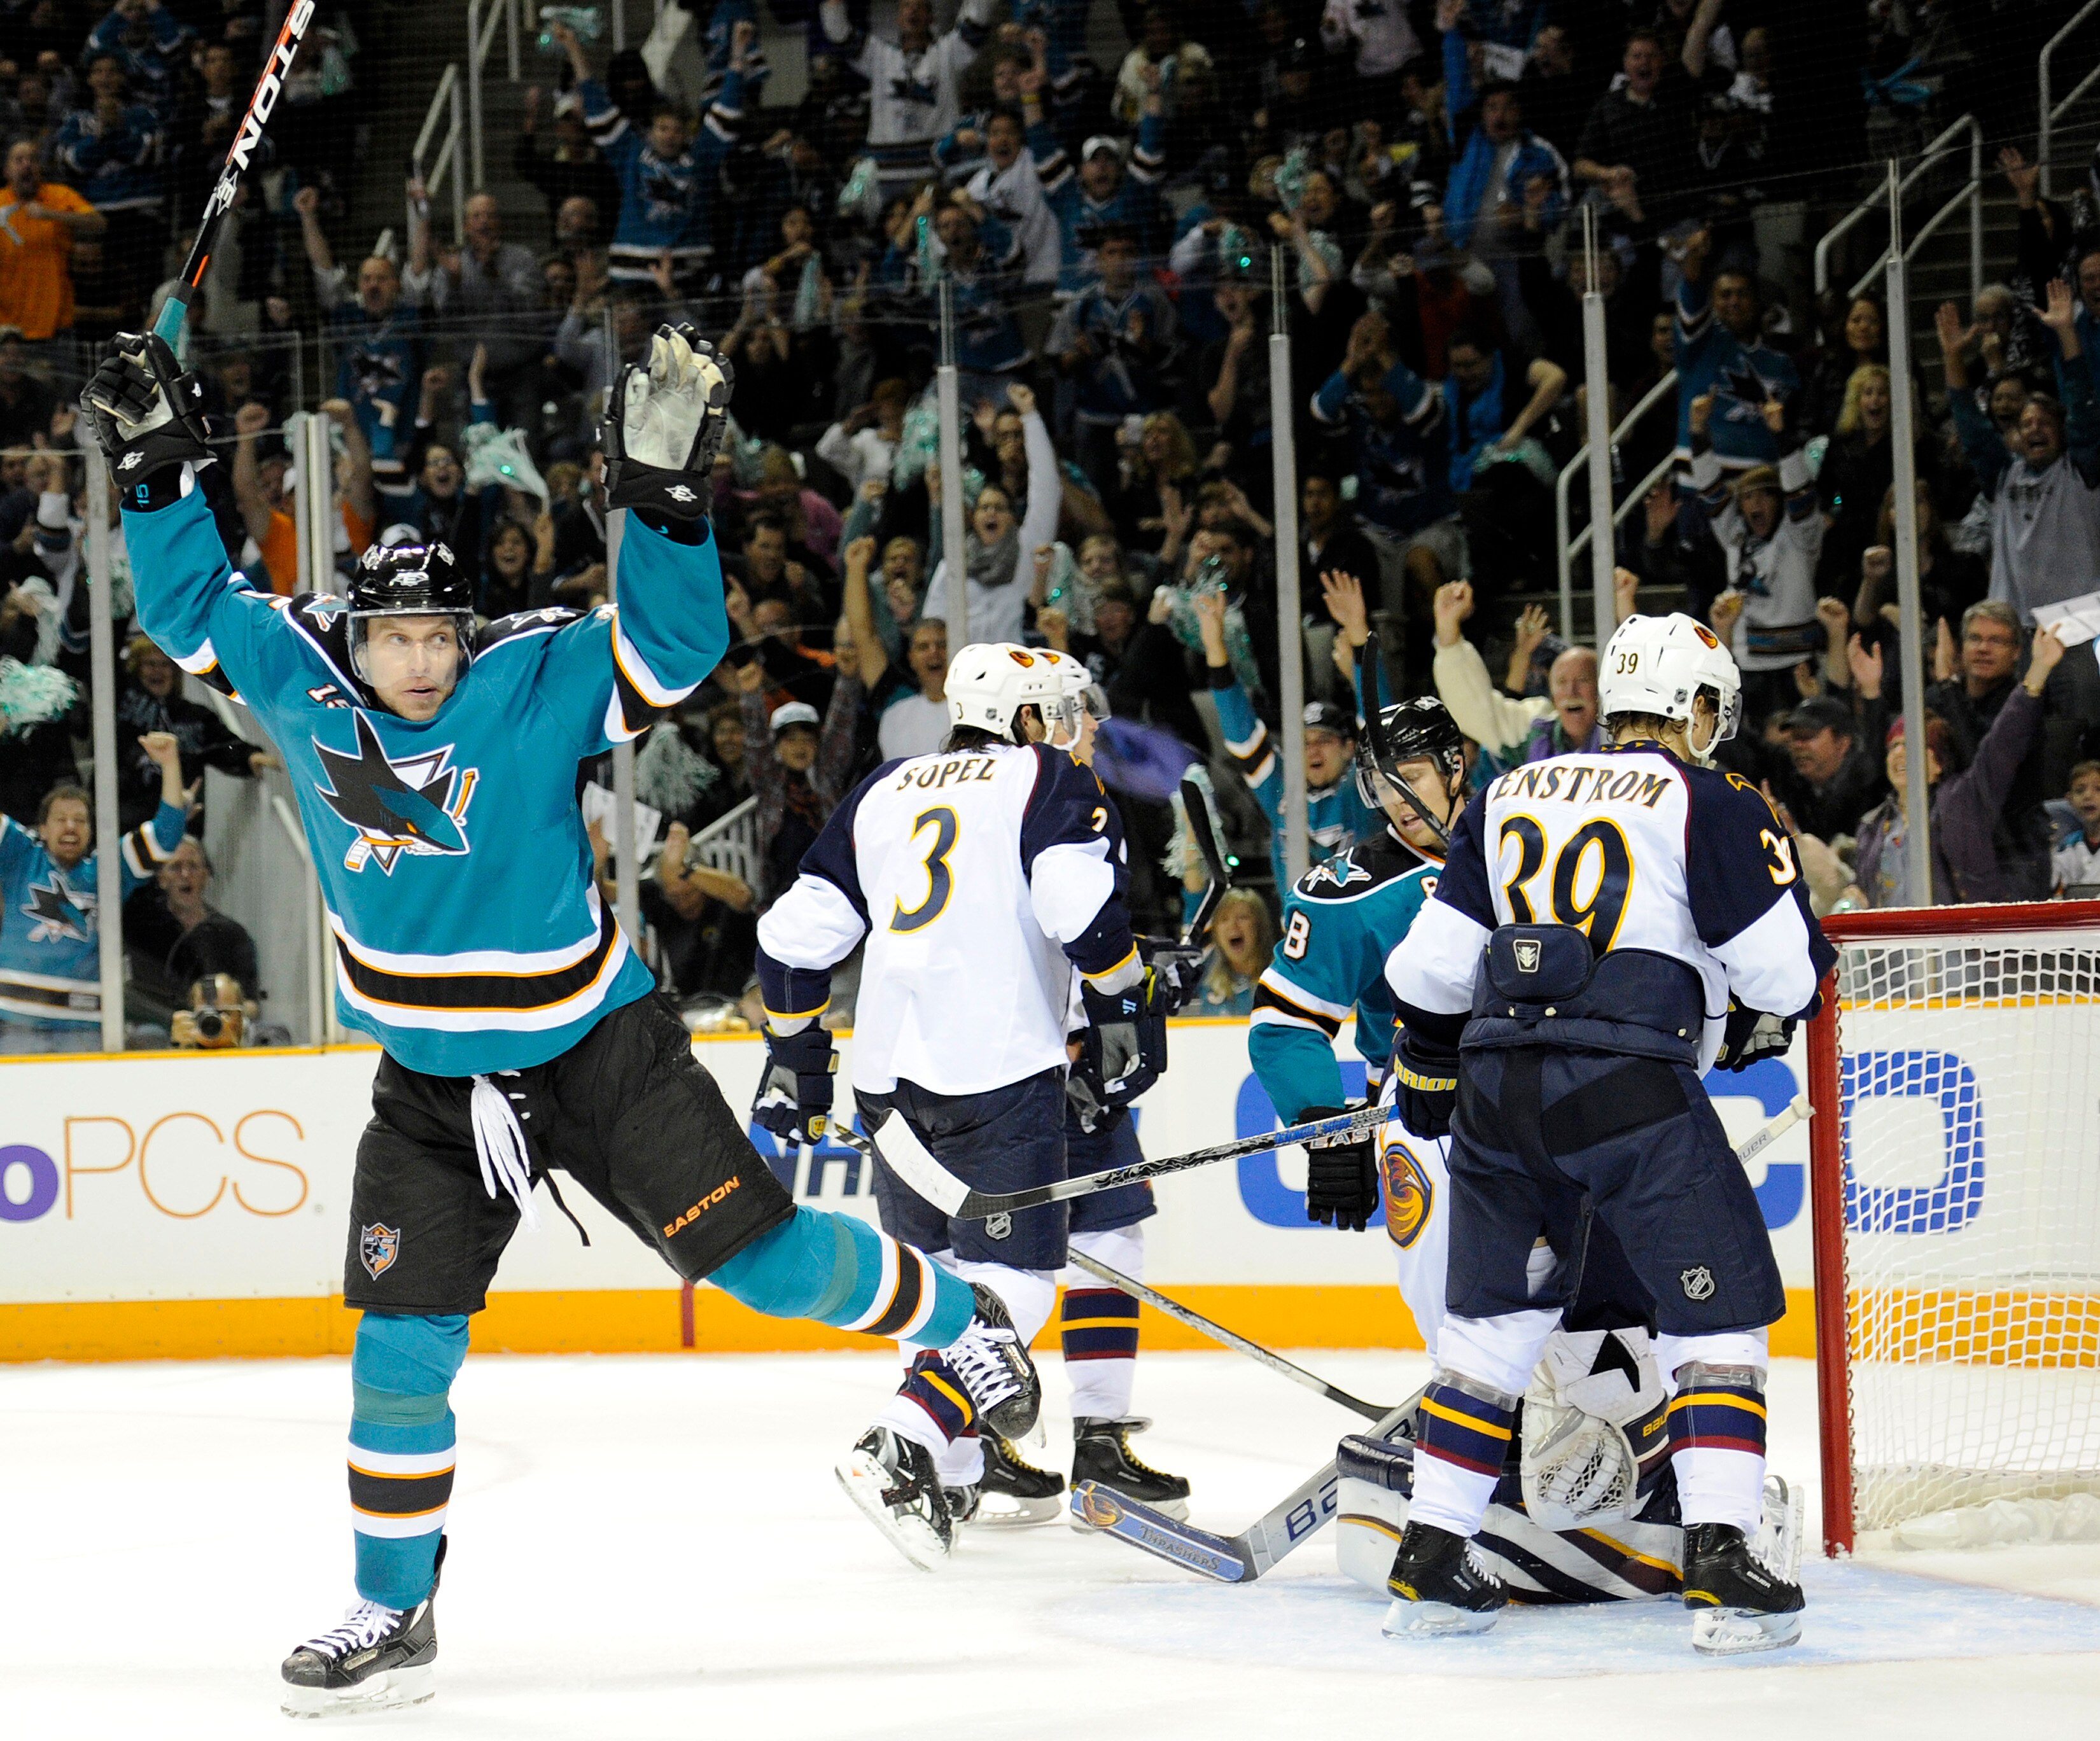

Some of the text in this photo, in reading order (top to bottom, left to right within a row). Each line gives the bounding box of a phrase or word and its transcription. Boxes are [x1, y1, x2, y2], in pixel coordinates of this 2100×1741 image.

[136, 484, 150, 508] 15
[1616, 652, 1639, 675] 39
[896, 759, 997, 791] SOPEL
[1492, 766, 1673, 809] ENSTROM
[887, 804, 961, 935] 3
[1499, 813, 1634, 952] 39
[1283, 910, 1312, 960] 8
[663, 1176, 740, 1238] EASTON
